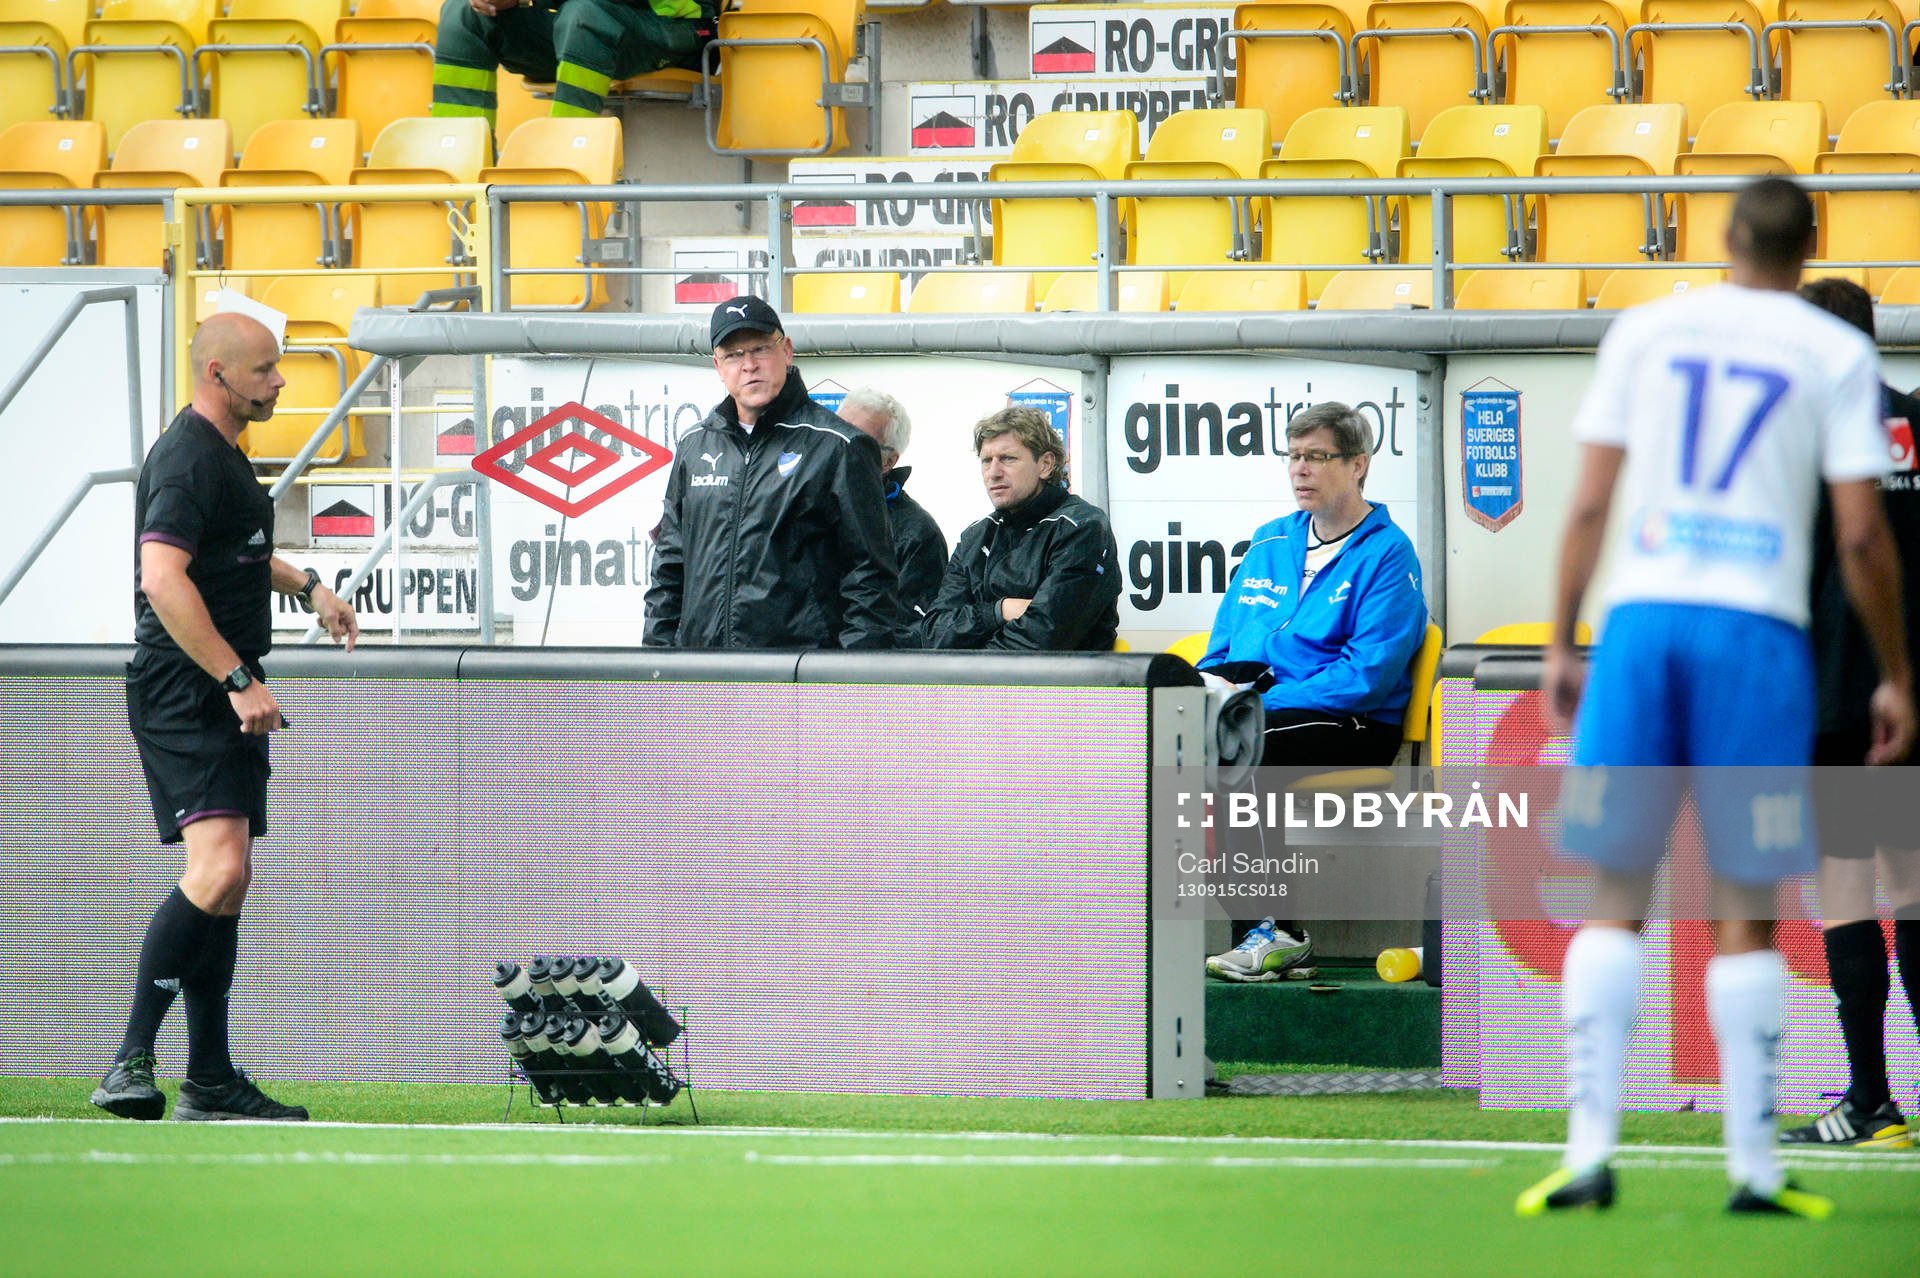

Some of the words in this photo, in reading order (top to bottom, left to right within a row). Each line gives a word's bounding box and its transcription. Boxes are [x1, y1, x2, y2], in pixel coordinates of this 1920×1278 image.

[1478, 411, 1503, 424] HELA
[1671, 360, 1790, 491] 17
[1467, 428, 1515, 442] SVERIGES
[1466, 445, 1516, 460] FOTBOLLS
[1476, 463, 1508, 477] KLUBB
